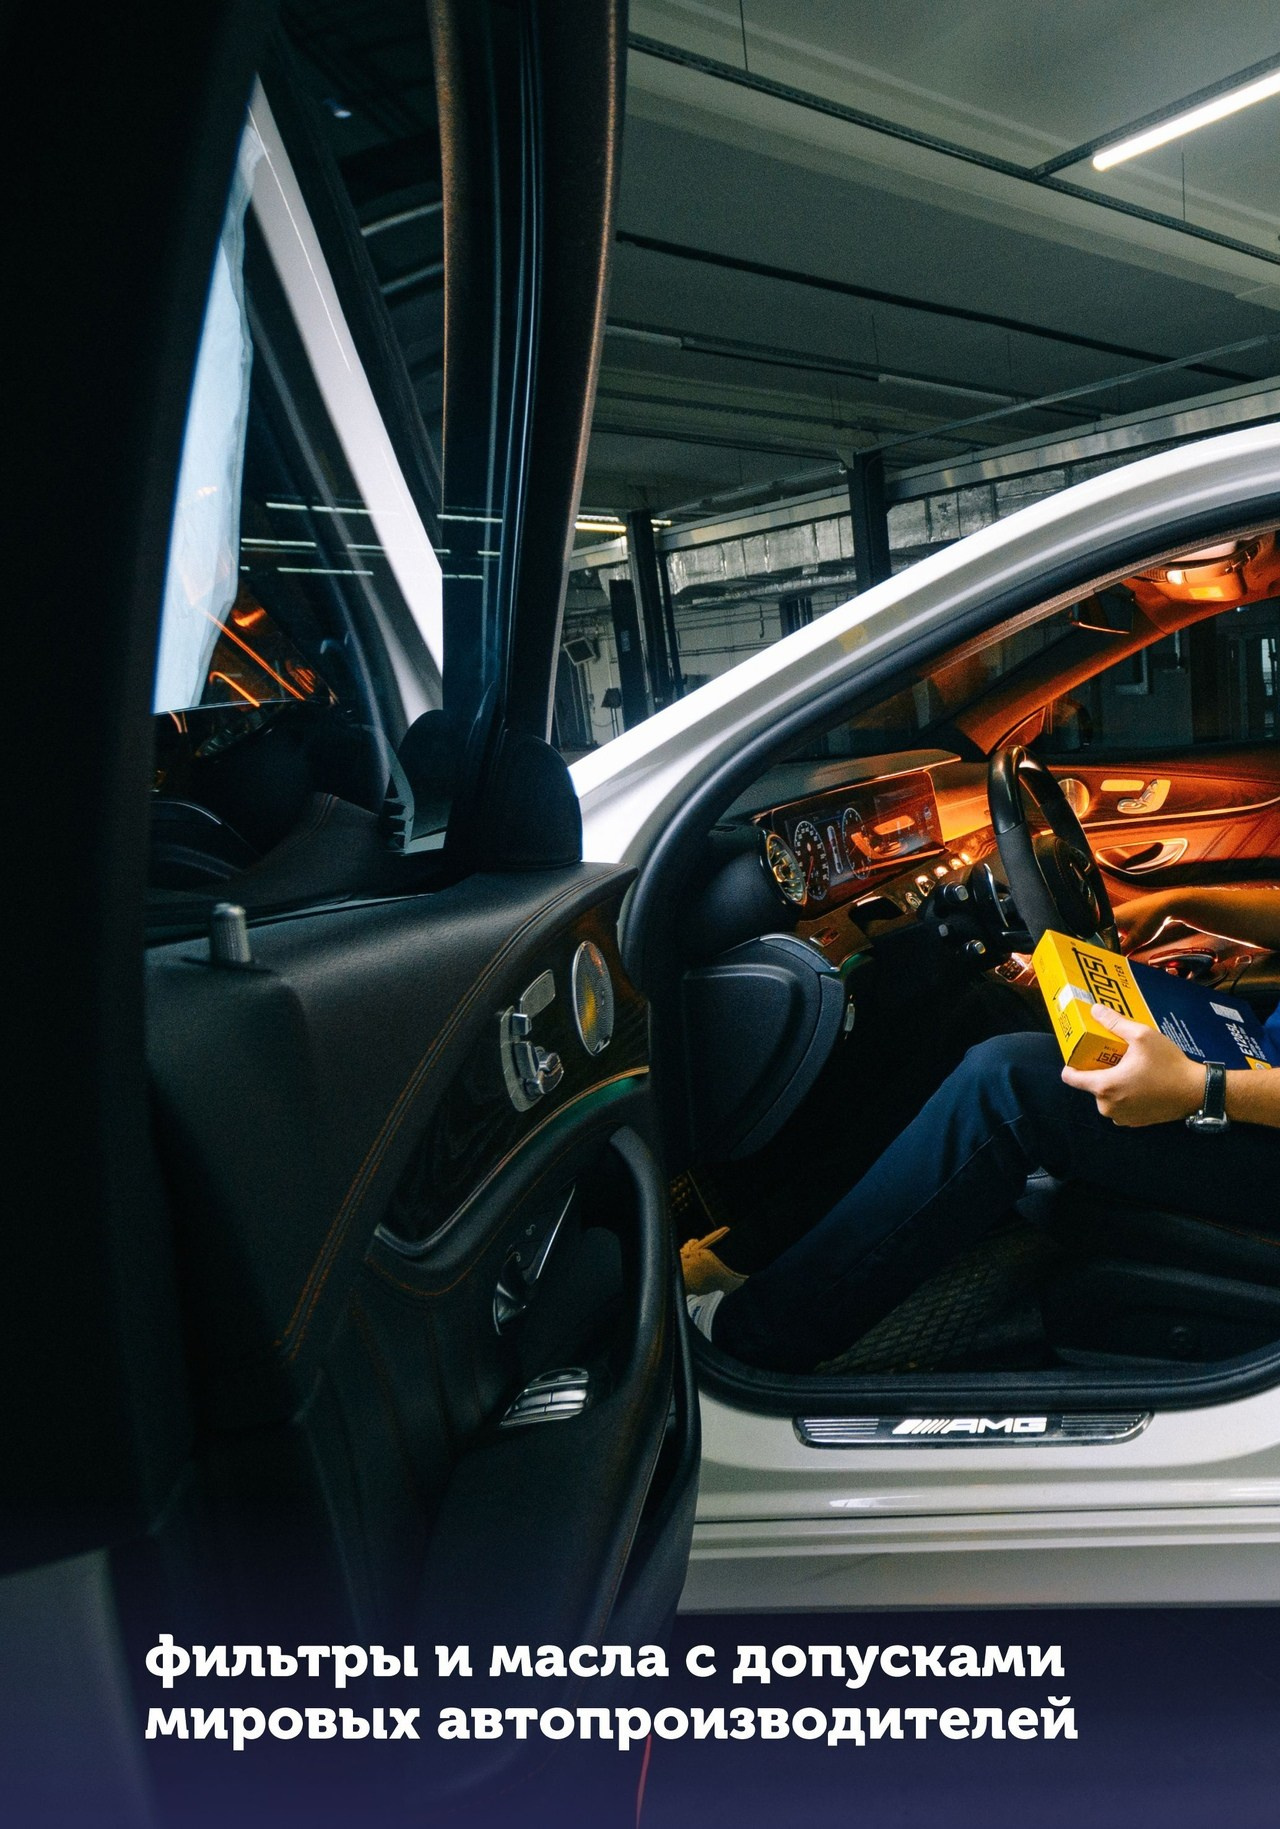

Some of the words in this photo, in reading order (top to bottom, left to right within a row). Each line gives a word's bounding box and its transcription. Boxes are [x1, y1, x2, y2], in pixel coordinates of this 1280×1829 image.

[1071, 946, 1135, 1020] engst
[1114, 963, 1132, 990] FILTER
[941, 1416, 1048, 1435] AMG
